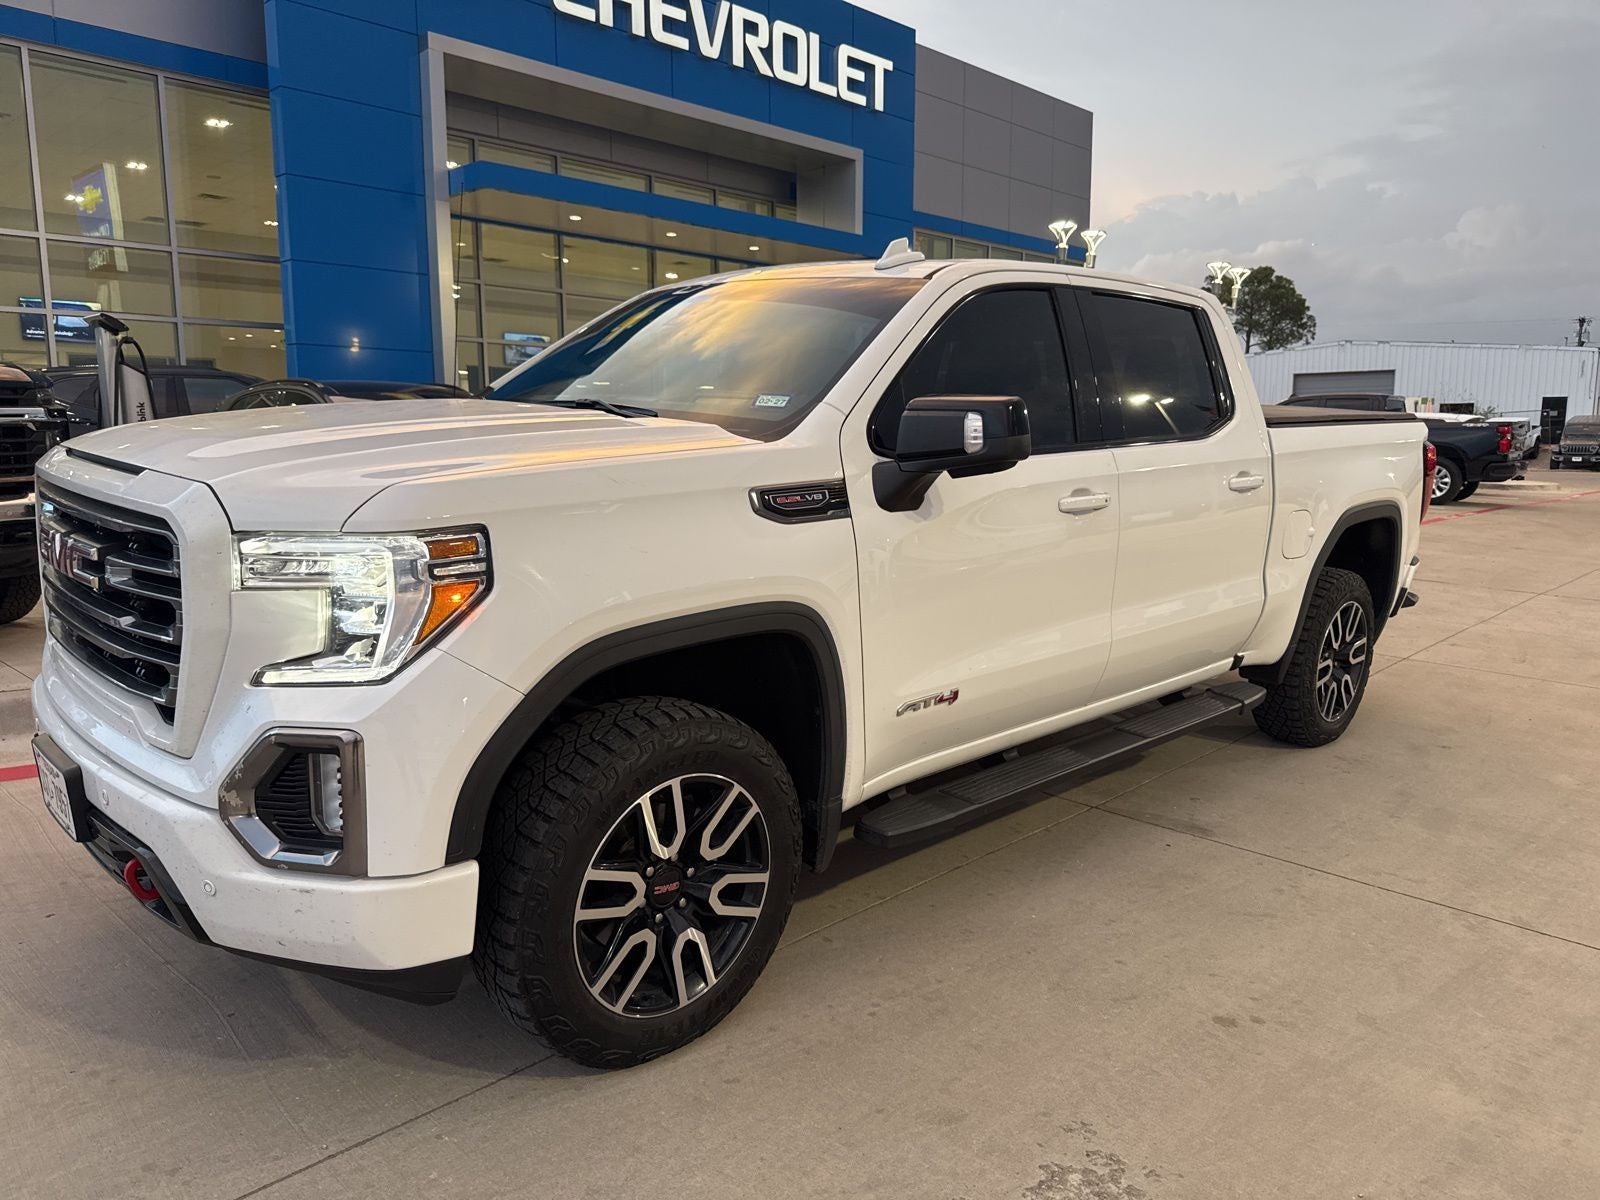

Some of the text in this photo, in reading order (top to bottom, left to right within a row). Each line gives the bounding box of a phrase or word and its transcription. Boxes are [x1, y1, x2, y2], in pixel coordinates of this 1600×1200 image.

[553, 0, 894, 112] HEVROLET
[136, 401, 146, 422] blink
[805, 493, 823, 501] V8
[896, 688, 959, 717] AT4
[654, 881, 680, 895] GMC
